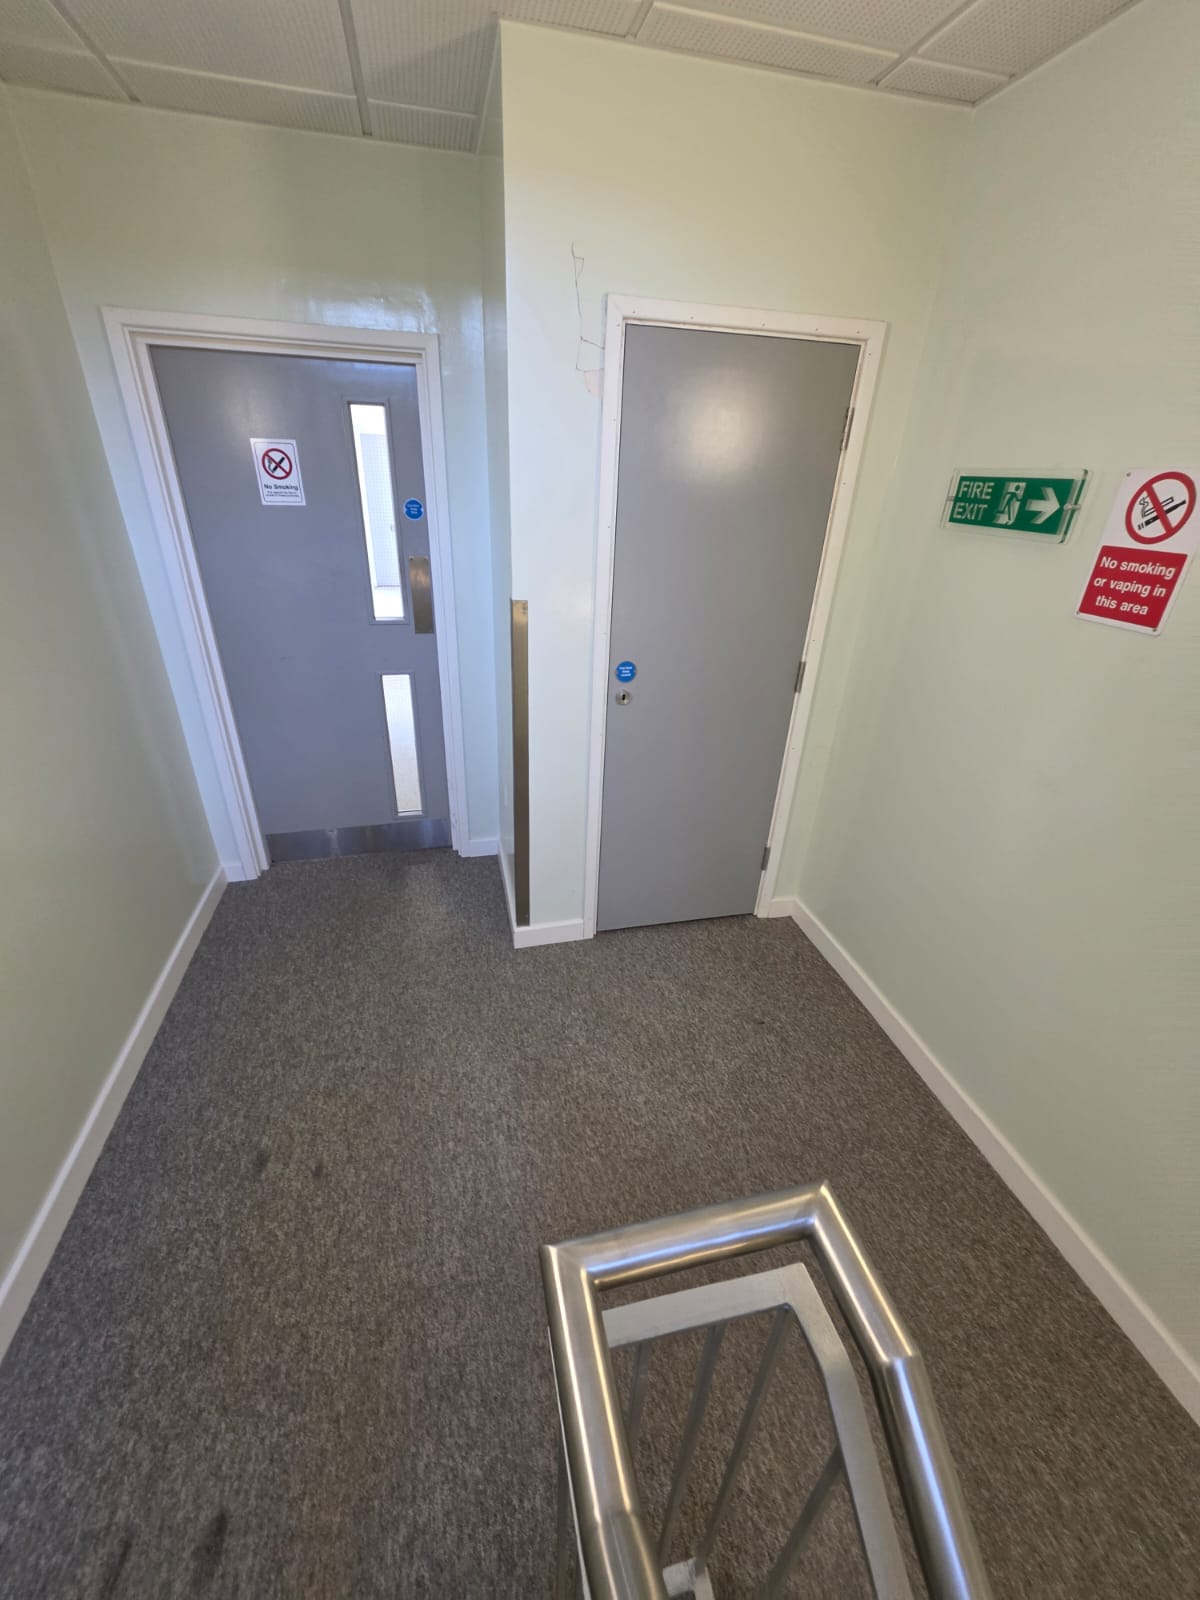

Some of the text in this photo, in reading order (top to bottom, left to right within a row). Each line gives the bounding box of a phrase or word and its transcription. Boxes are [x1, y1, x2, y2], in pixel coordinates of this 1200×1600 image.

[958, 481, 995, 499] FIRE
[952, 502, 988, 520] EXIT
[1100, 556, 1176, 580] No smoking
[1093, 577, 1166, 598] or vaping in
[1095, 595, 1149, 615] this area
